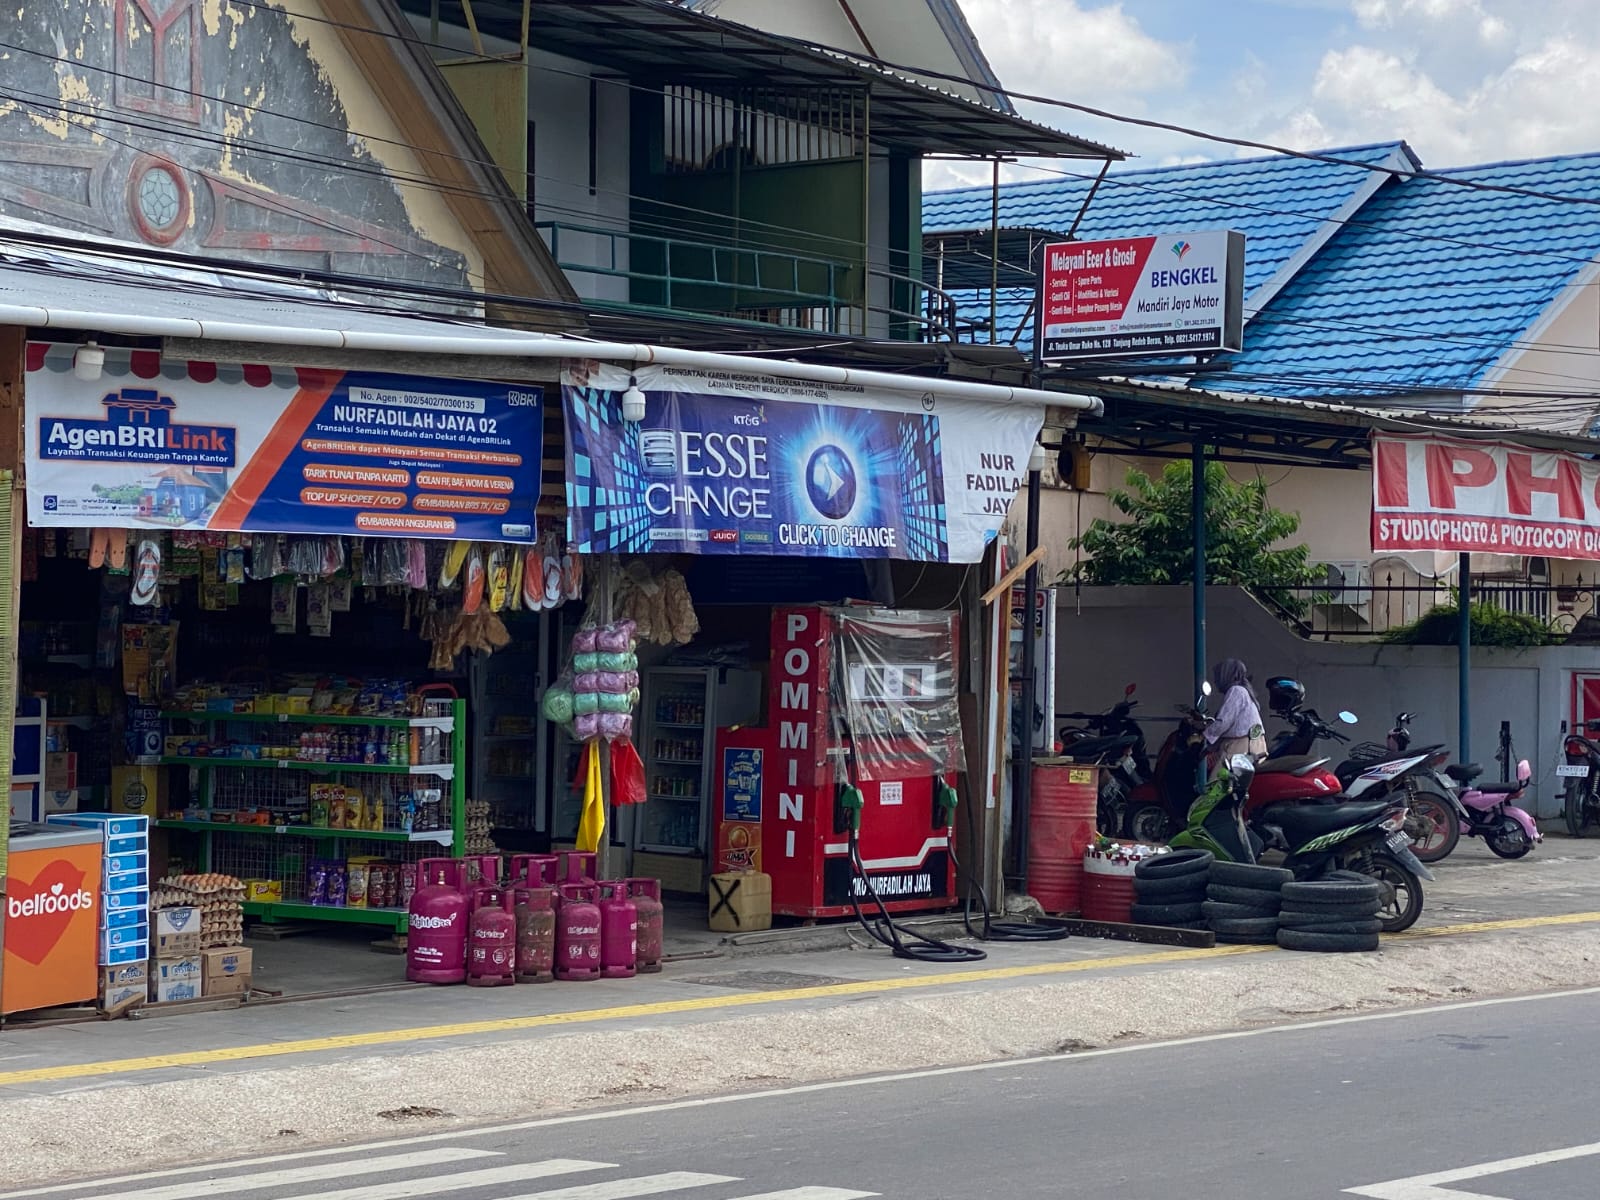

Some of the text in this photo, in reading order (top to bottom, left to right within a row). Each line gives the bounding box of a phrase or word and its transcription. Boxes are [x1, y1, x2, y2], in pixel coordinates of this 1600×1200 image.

[1051, 246, 1136, 274] Melayani Ecer & Grosir
[1151, 266, 1218, 288] BENGKEL
[1137, 294, 1219, 314] Mandiri Jaya Motor
[360, 390, 374, 401] No.
[376, 392, 397, 404] Agen
[519, 394, 537, 407] BRI
[334, 405, 498, 434] NURFADILAH JAYA 02
[734, 414, 760, 427] KT&G
[48, 422, 228, 452] AgenBRILink
[316, 424, 512, 447] Transaksi Semakin Mudah dan Dekat di AgenBRILink
[48, 447, 230, 464] Layanan Transaksi Keuangan Tanpa Kantor
[358, 443, 381, 454] dapat
[382, 446, 418, 456] Melayani
[419, 448, 446, 458] Semua
[446, 450, 480, 461] Transaksi
[481, 453, 519, 464] Perbankan
[679, 431, 770, 480] ESSE
[979, 452, 1015, 472] NUR
[304, 467, 409, 484] TARIK TUNAI TANPA KARTU
[966, 473, 1025, 494] FADILA
[1376, 440, 1600, 521] IPH
[305, 491, 324, 502] TOP
[324, 493, 339, 503] UP
[339, 493, 375, 504] SHOPEE
[380, 495, 402, 506] OVO
[645, 482, 773, 520] CHANGE
[982, 497, 1014, 515] JAY
[713, 532, 737, 541] JUICY
[778, 522, 897, 549] CLICK TO CHANGE
[1585, 531, 1600, 553] DI
[914, 873, 931, 894] JAYA
[8, 888, 94, 919] belfoods
[431, 916, 452, 929] Gas
